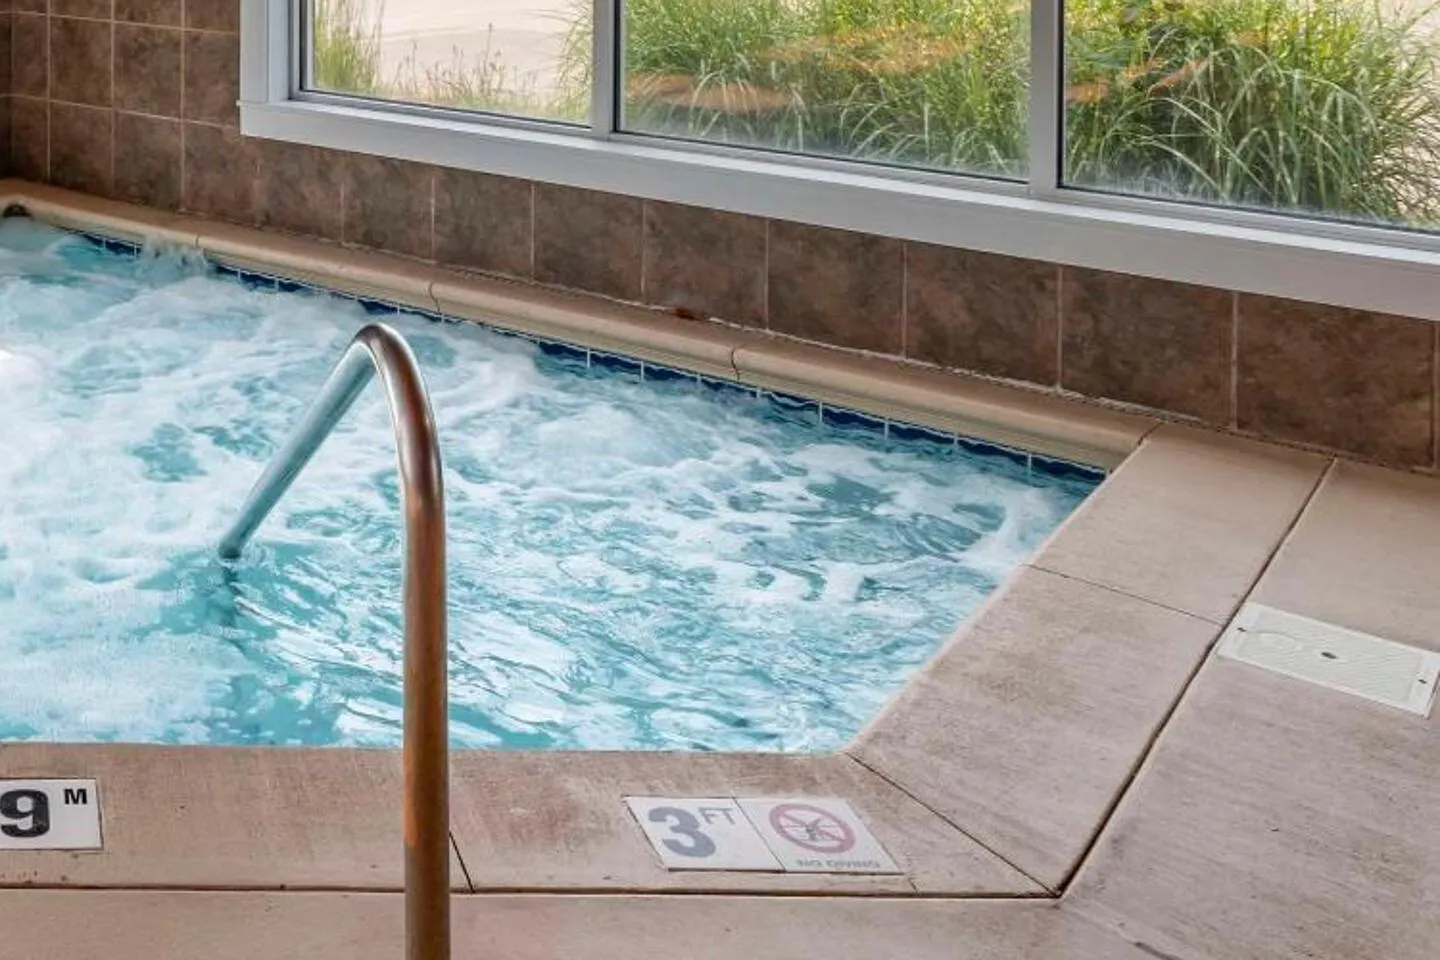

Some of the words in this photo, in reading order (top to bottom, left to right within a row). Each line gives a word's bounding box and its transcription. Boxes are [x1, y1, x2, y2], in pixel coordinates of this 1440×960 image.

[63, 788, 88, 805] M
[648, 806, 717, 858] 3
[698, 807, 736, 825] FT
